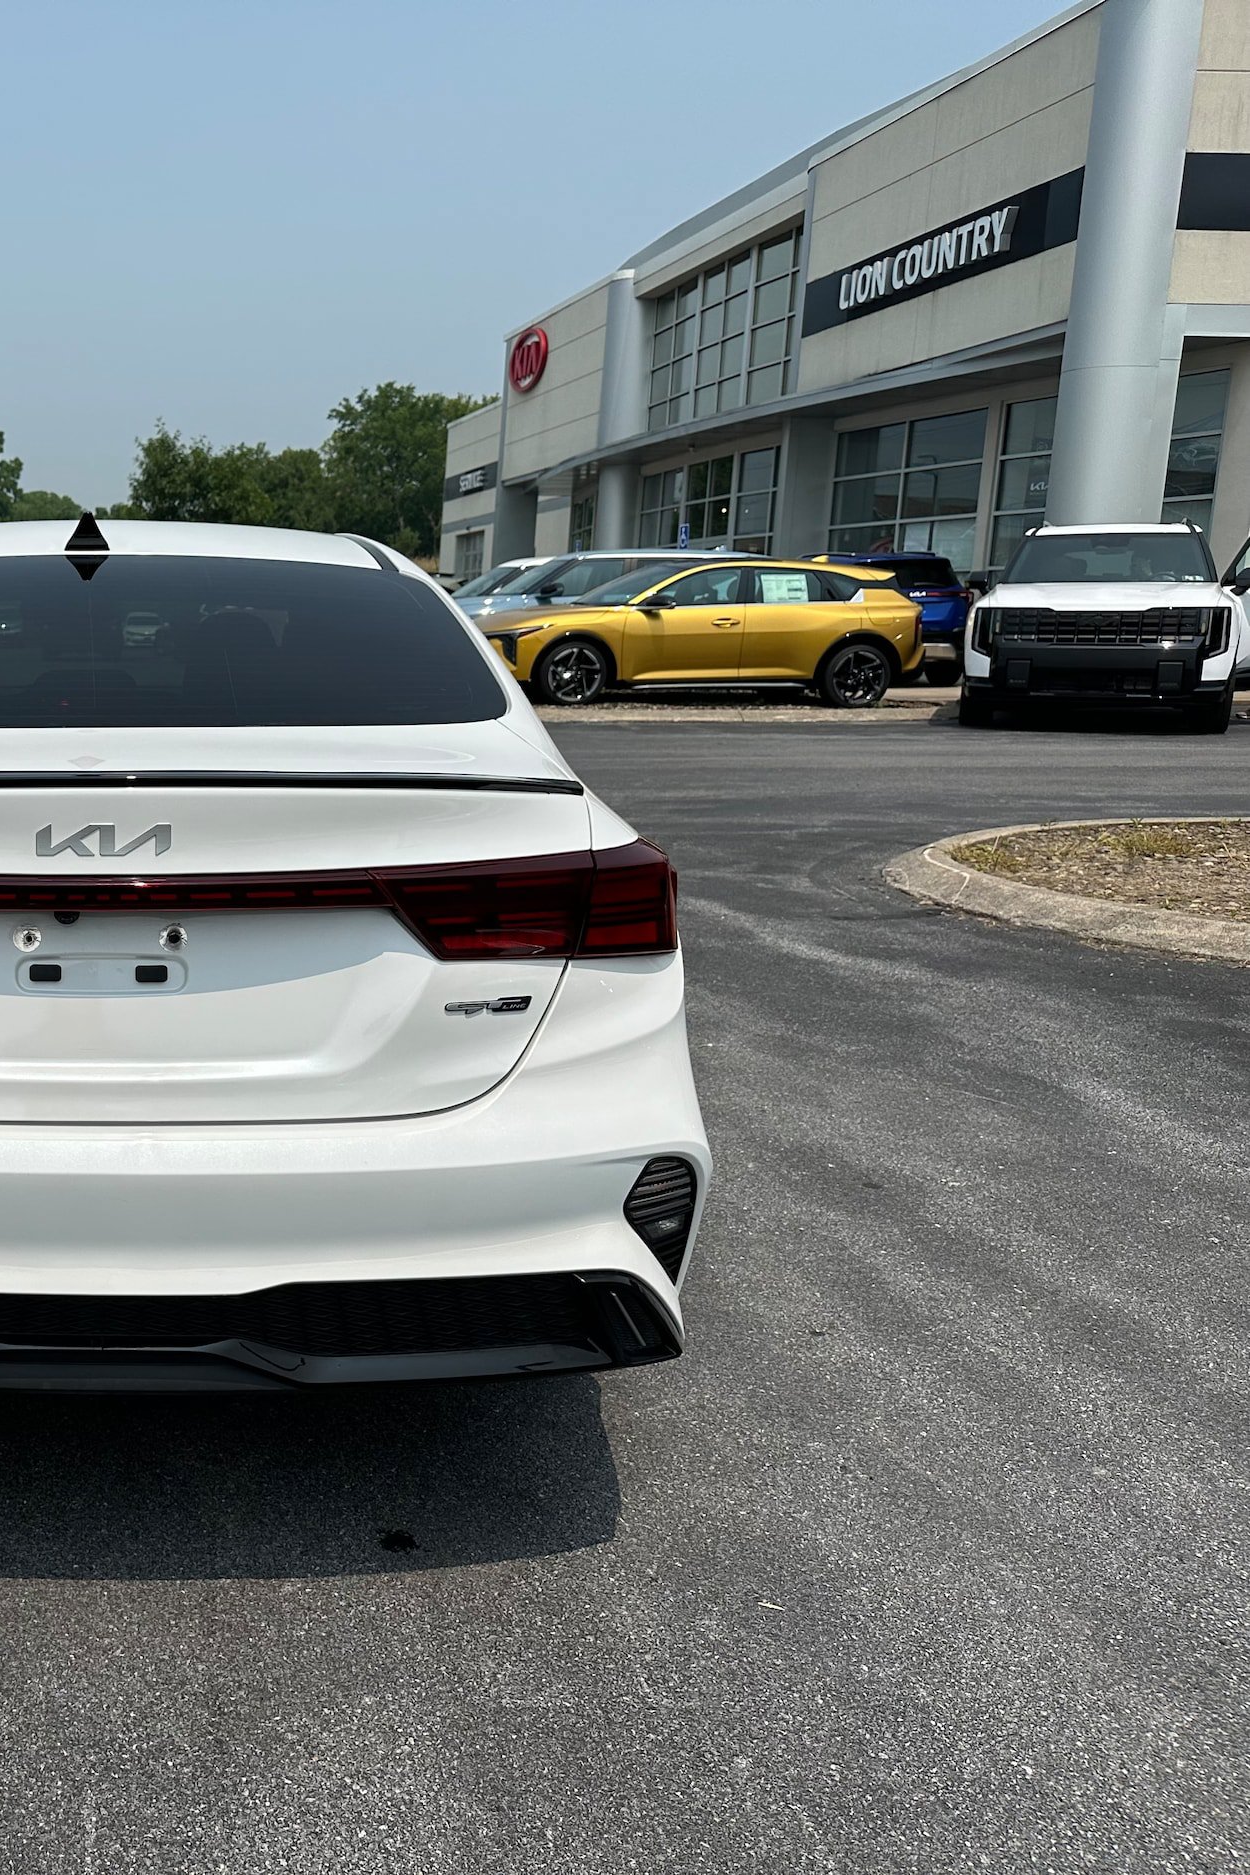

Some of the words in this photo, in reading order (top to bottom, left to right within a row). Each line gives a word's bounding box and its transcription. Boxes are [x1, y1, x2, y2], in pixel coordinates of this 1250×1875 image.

[838, 256, 893, 311] LION
[892, 206, 1018, 290] COUNTRY
[513, 342, 539, 381] KIA
[35, 822, 172, 857] KIA
